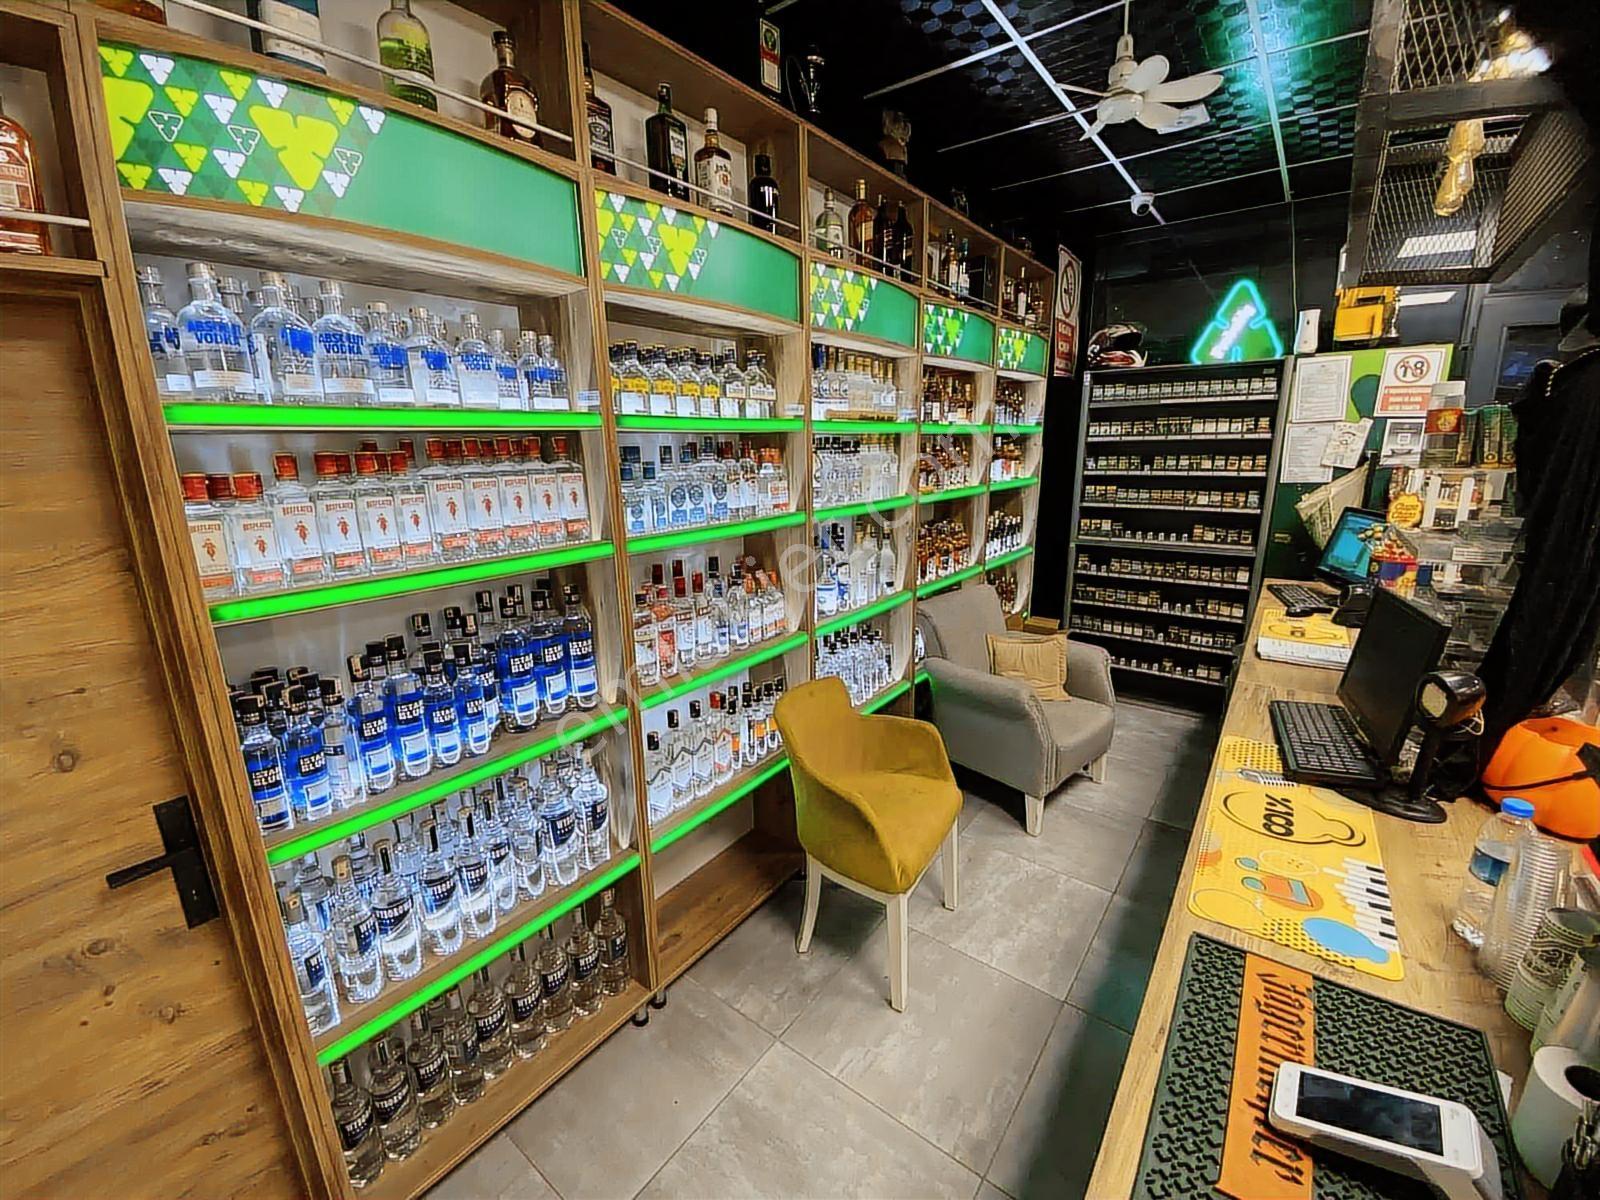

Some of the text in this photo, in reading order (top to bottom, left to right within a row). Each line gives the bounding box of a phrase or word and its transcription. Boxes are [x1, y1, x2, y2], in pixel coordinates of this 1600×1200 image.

[195, 332, 241, 347] VODKA
[324, 344, 362, 355] VODKA
[1244, 973, 1313, 1186] Jägermer
